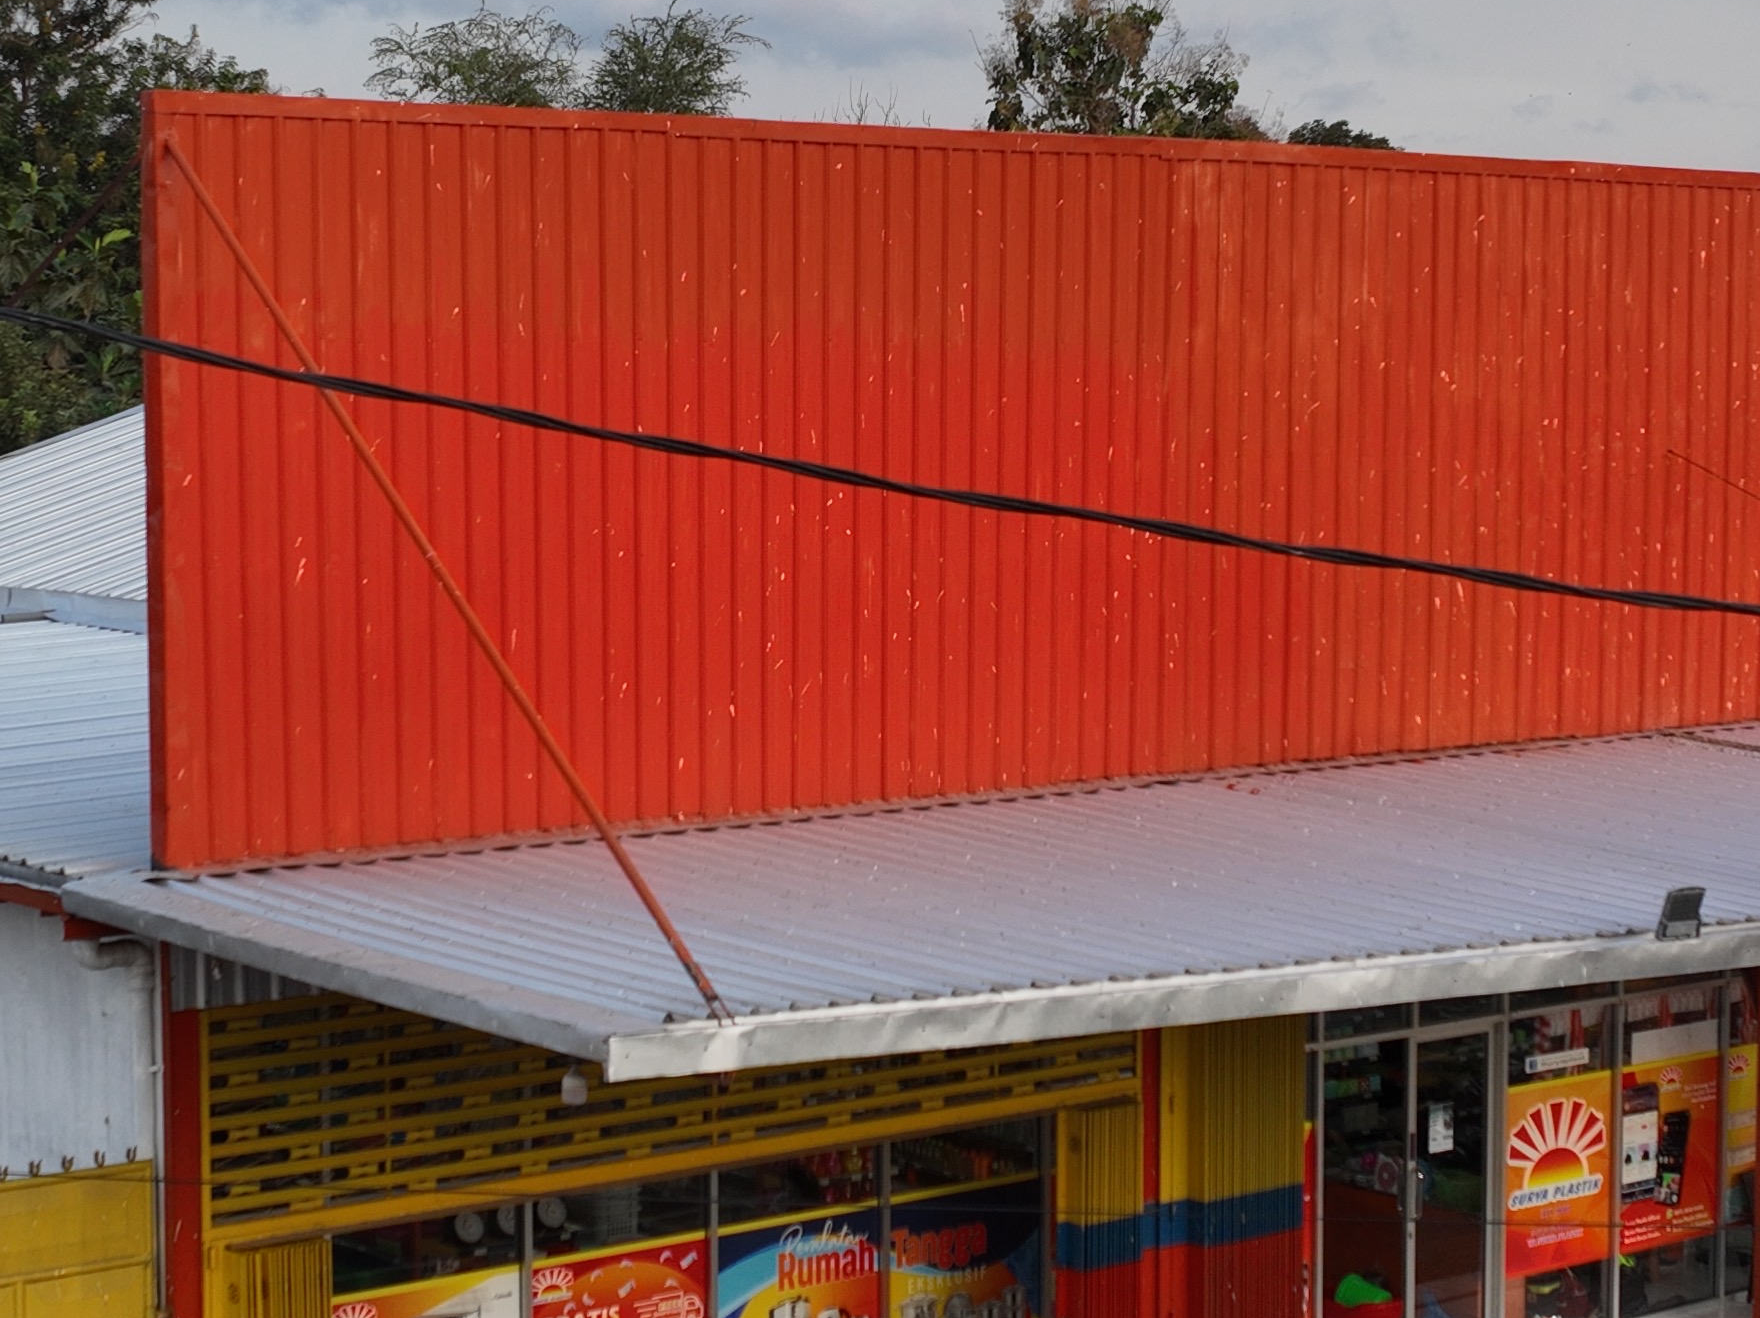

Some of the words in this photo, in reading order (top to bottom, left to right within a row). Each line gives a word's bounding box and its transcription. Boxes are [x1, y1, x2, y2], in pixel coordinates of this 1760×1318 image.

[1511, 1187, 1549, 1208] SURYA
[1552, 1178, 1602, 1199] PLASTIK
[776, 1239, 878, 1293] Rumah
[891, 1221, 988, 1270] Tangga
